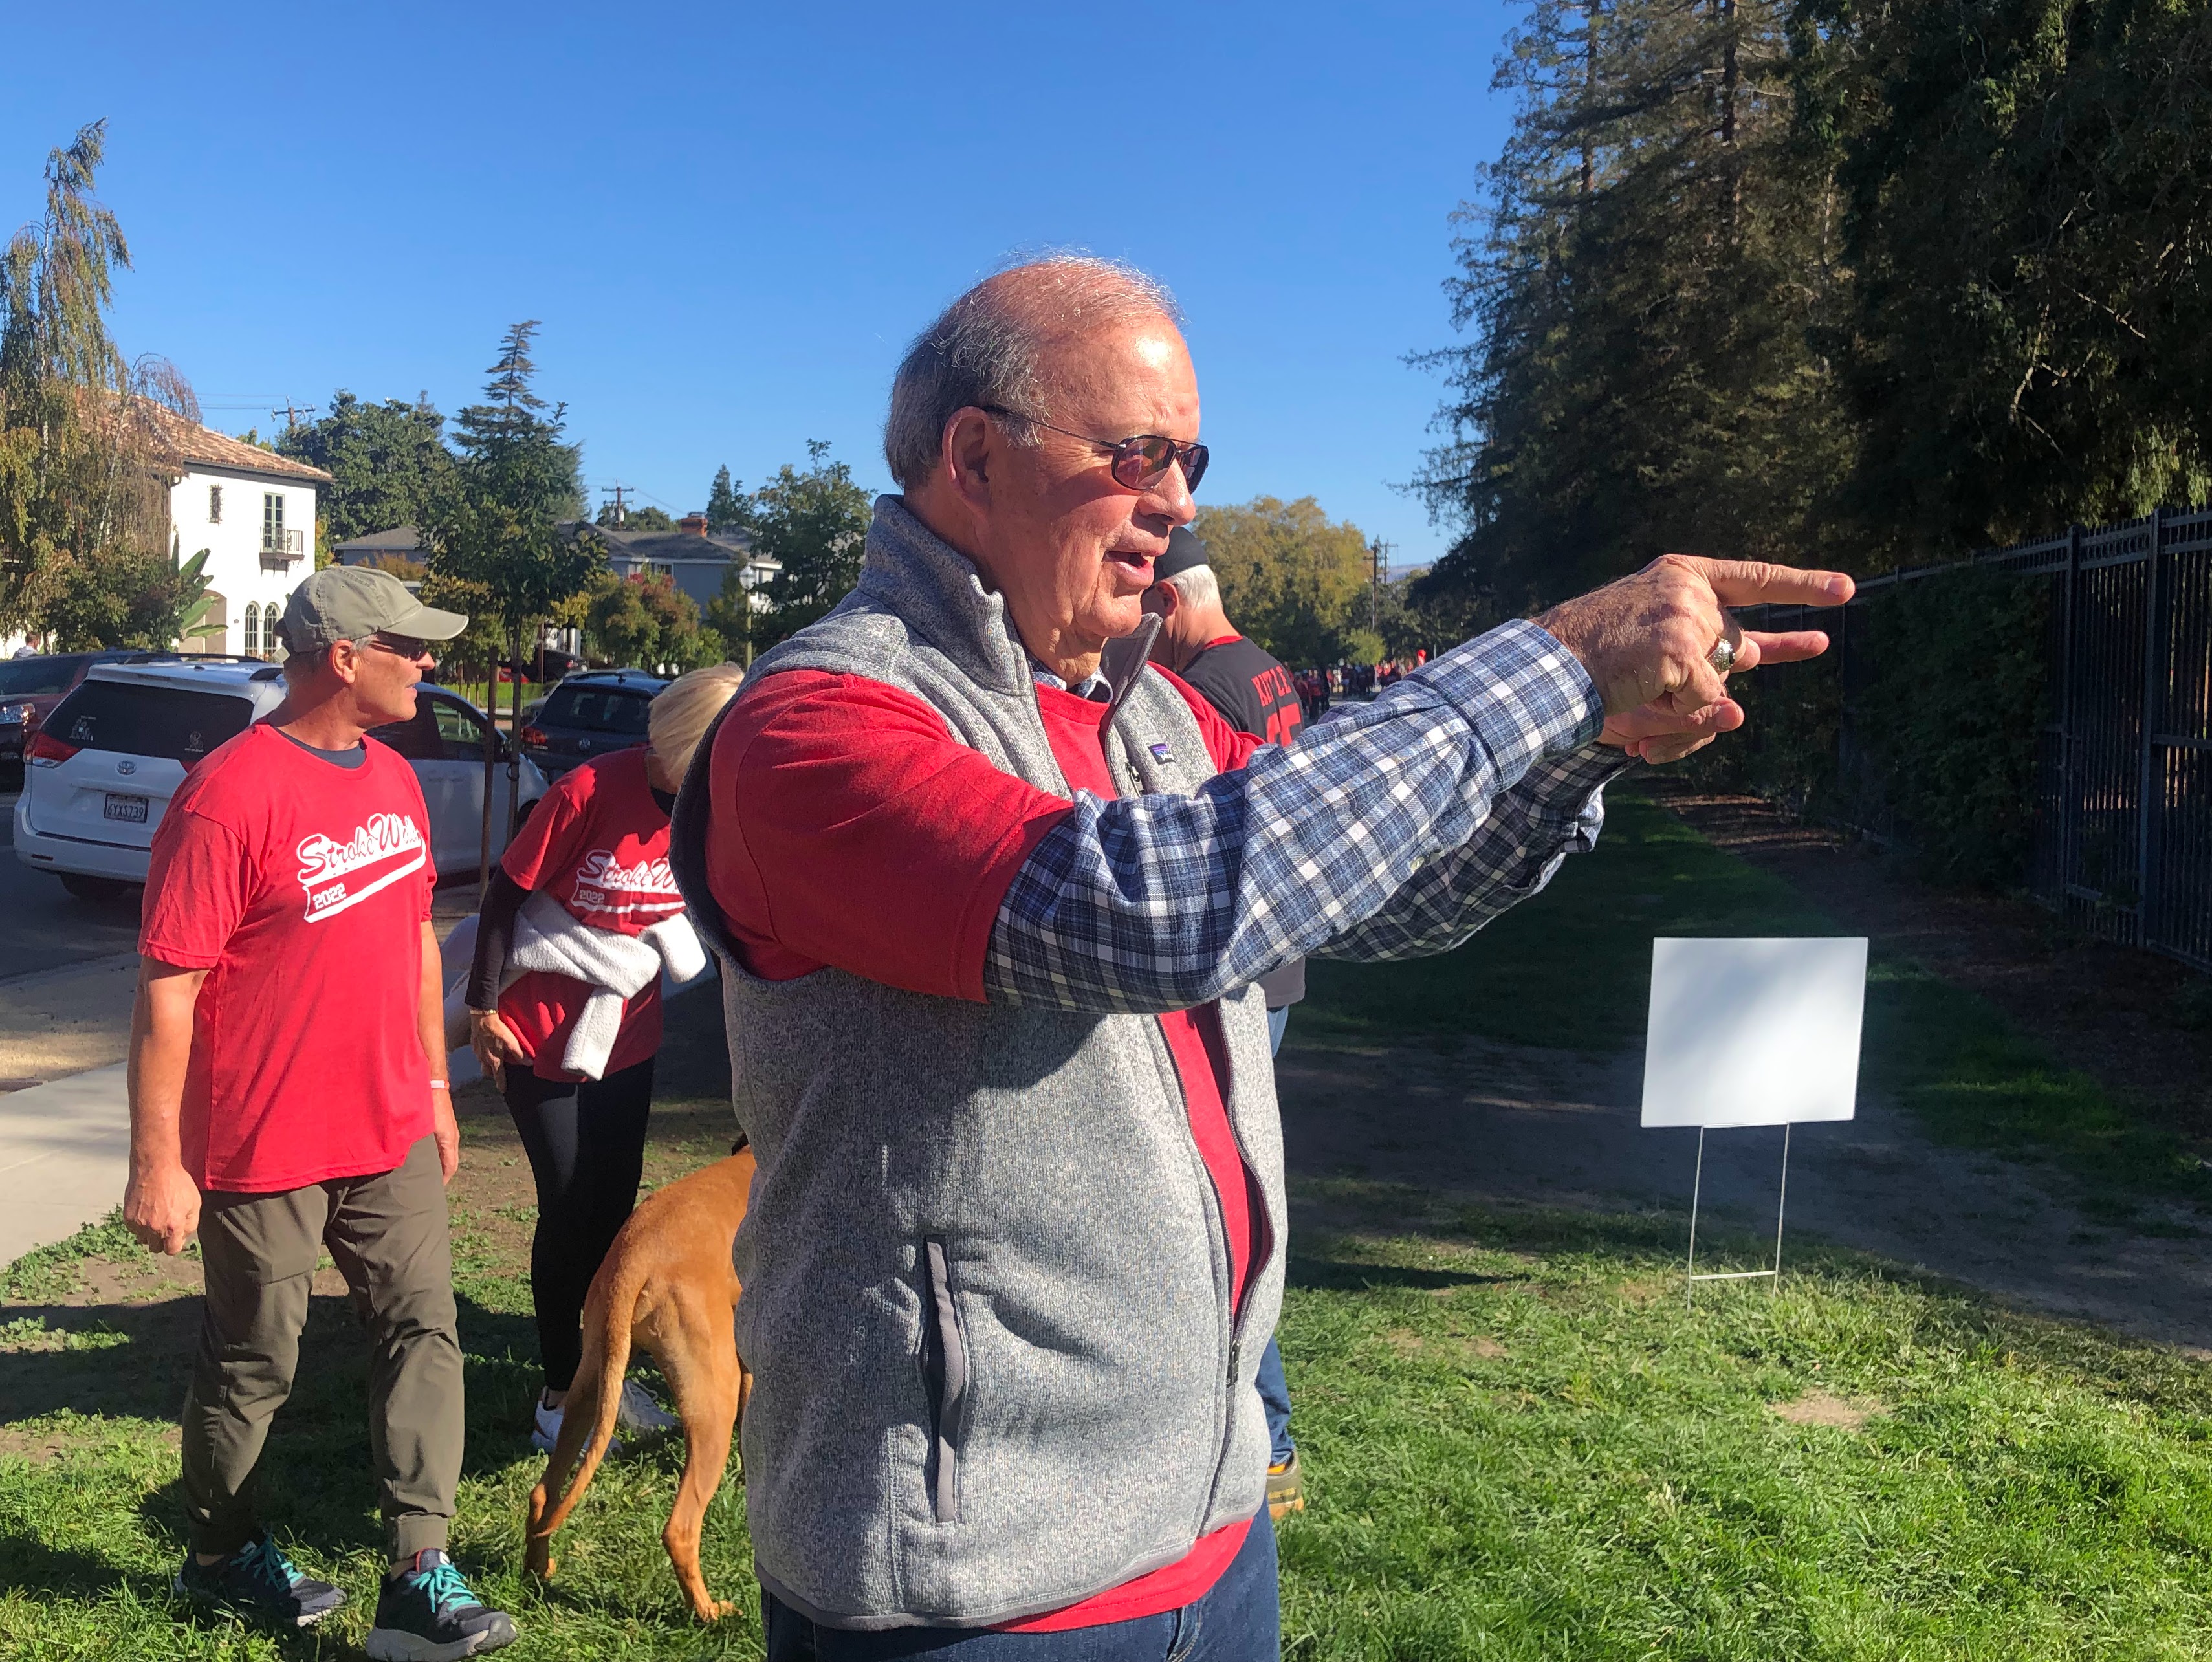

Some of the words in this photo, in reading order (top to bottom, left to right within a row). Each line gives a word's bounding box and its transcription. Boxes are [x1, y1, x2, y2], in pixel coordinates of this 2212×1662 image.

[1251, 666, 1292, 706] KITLE
[107, 803, 144, 818] 6YXS739
[312, 882, 347, 910] 2022
[579, 890, 606, 904] 2022
